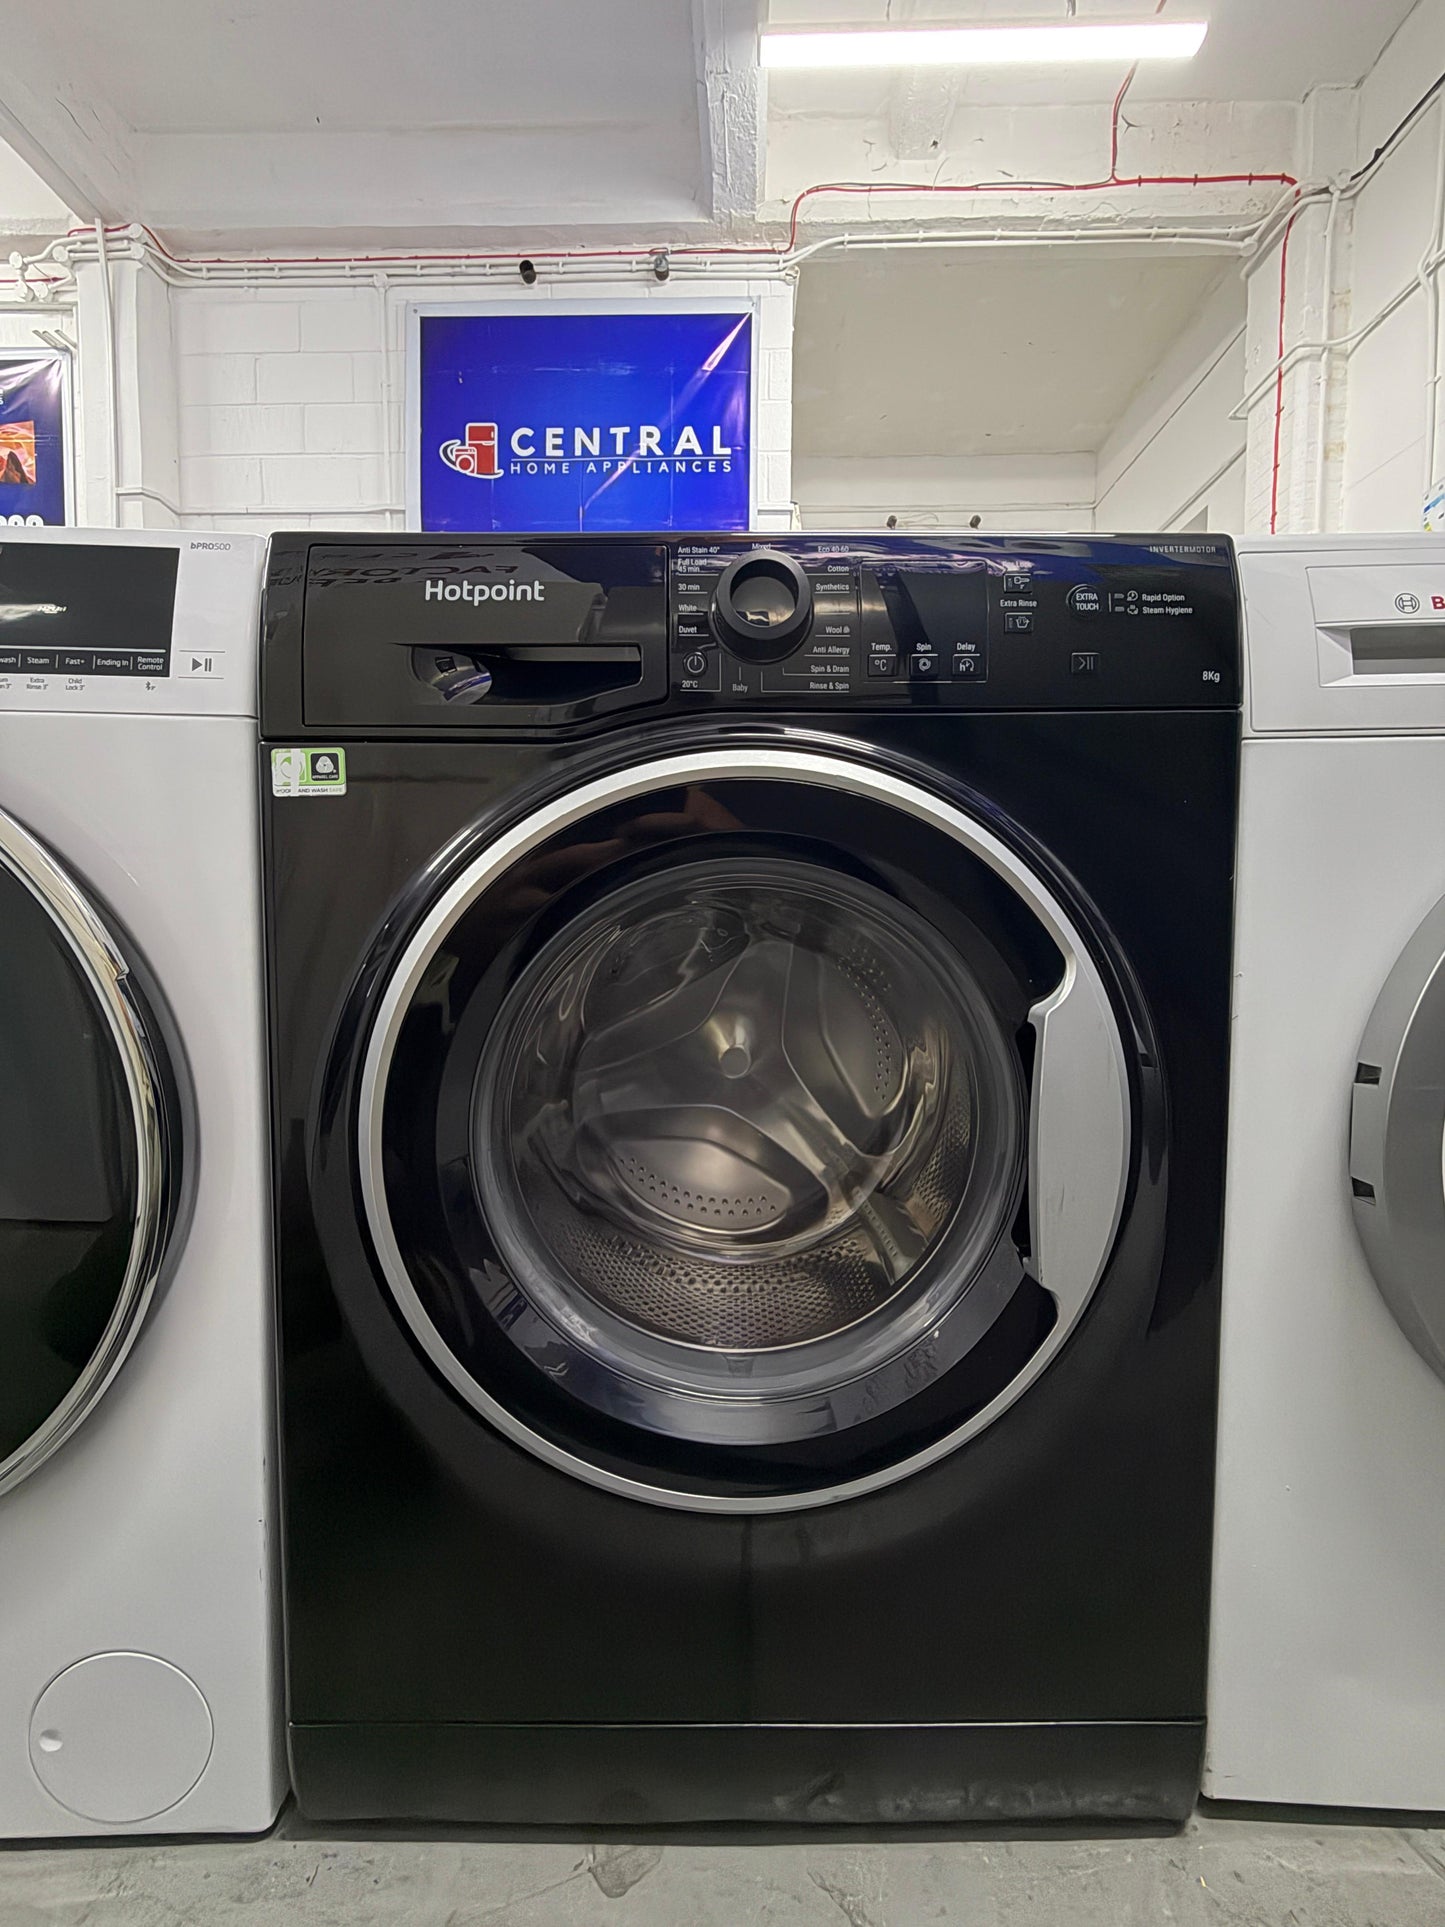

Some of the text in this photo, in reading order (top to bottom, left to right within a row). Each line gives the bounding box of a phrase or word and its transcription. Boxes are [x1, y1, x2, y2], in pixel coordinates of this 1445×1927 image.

[510, 425, 732, 457] CENTRAL
[510, 460, 732, 475] HOME APPLIANCES
[190, 542, 231, 551] bPRO500
[677, 546, 691, 554] Anti
[692, 546, 708, 554] Stain
[827, 565, 850, 573] Cotton
[815, 584, 850, 592] Synthetics
[425, 579, 545, 606] Hotpoint
[1076, 593, 1099, 601] EXTRA
[1142, 593, 1185, 602] Rapid Option
[1000, 600, 1038, 608] Extra Rinse
[1076, 603, 1099, 611] TOUCH
[1142, 606, 1193, 616] Steam Hygiene
[678, 626, 698, 634] Duvet
[825, 626, 843, 634] Wool
[812, 646, 850, 656] Anti Allergy
[871, 643, 892, 651] Temp.
[916, 643, 932, 651] Spin
[956, 642, 976, 652] Delay
[27, 656, 50, 664] Steam
[97, 658, 129, 668] Ending In
[137, 656, 165, 664] Remote
[137, 663, 163, 671] Control
[810, 666, 825, 674] Spin
[832, 665, 850, 673] Drain
[1202, 670, 1220, 683] 8Kg
[681, 680, 699, 688] 20°C
[732, 683, 749, 693] Baby
[810, 682, 850, 691] Rinse & Spin
